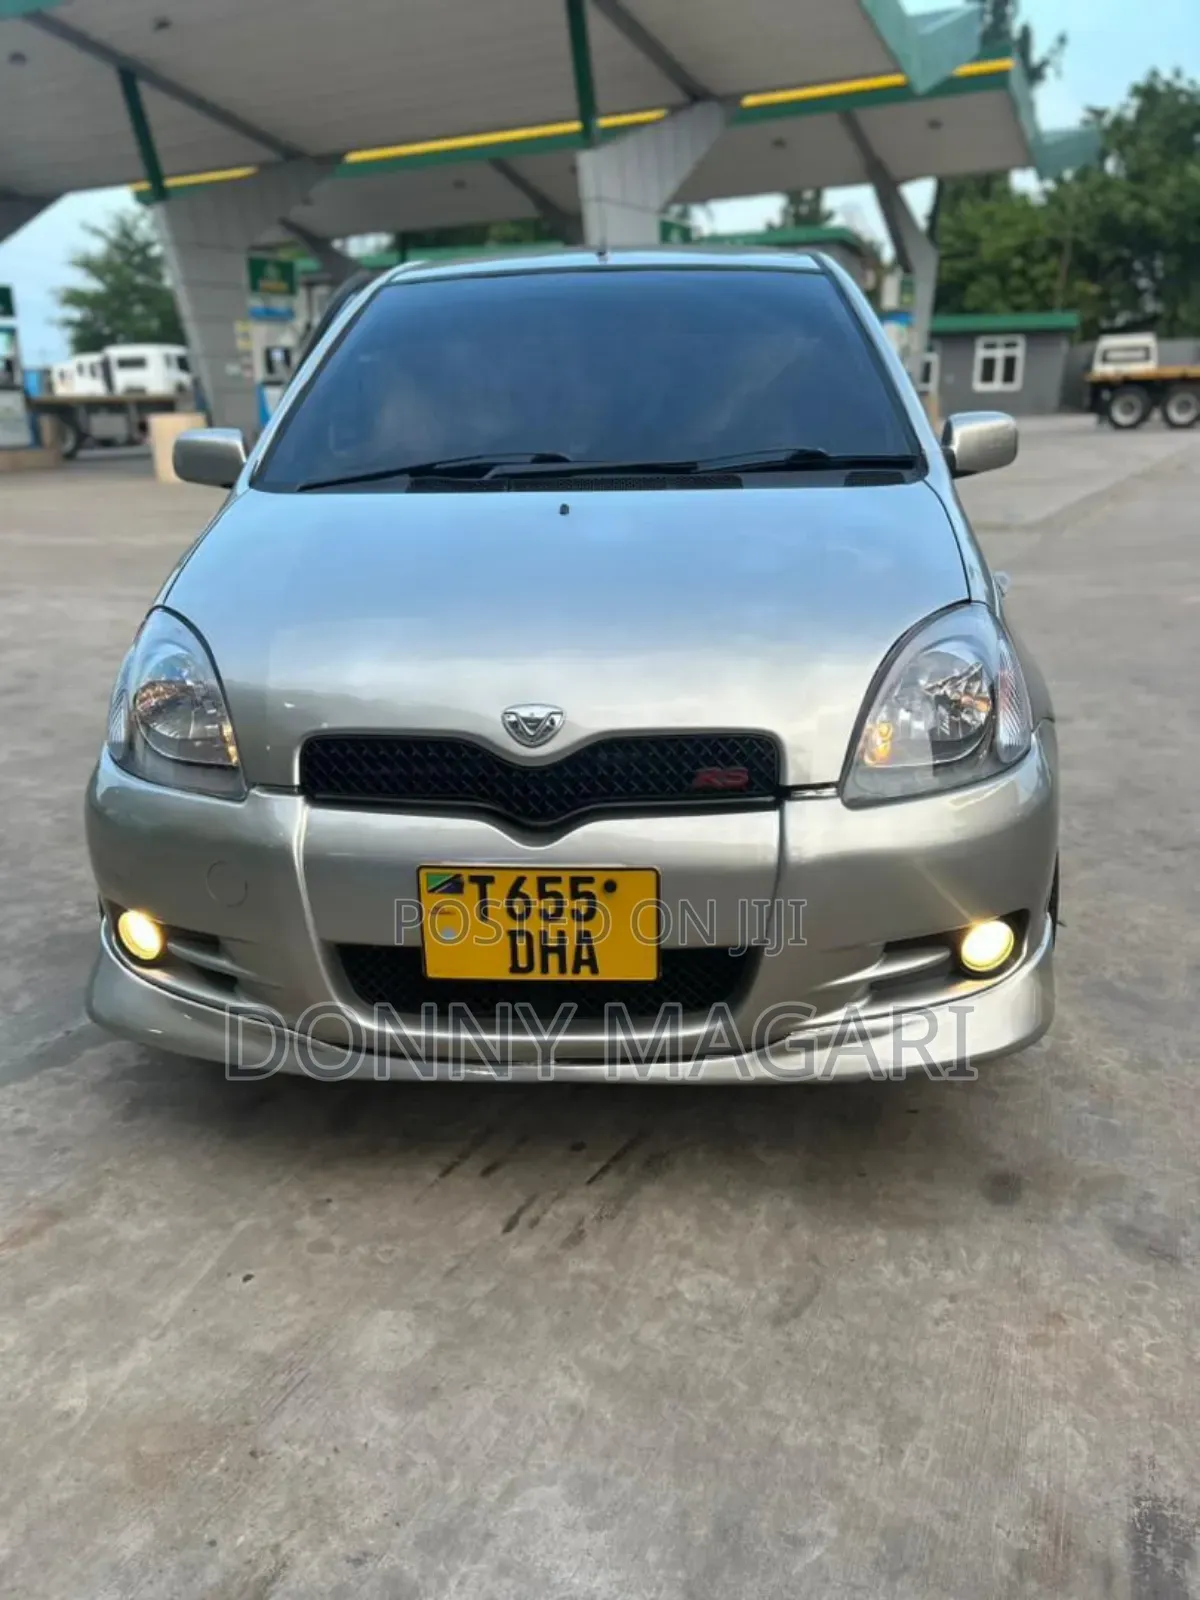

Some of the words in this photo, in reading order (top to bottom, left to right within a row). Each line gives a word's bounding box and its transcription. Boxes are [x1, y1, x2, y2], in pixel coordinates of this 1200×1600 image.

[468, 874, 495, 922] T
[506, 875, 597, 923] 655
[508, 928, 600, 976] DHA
